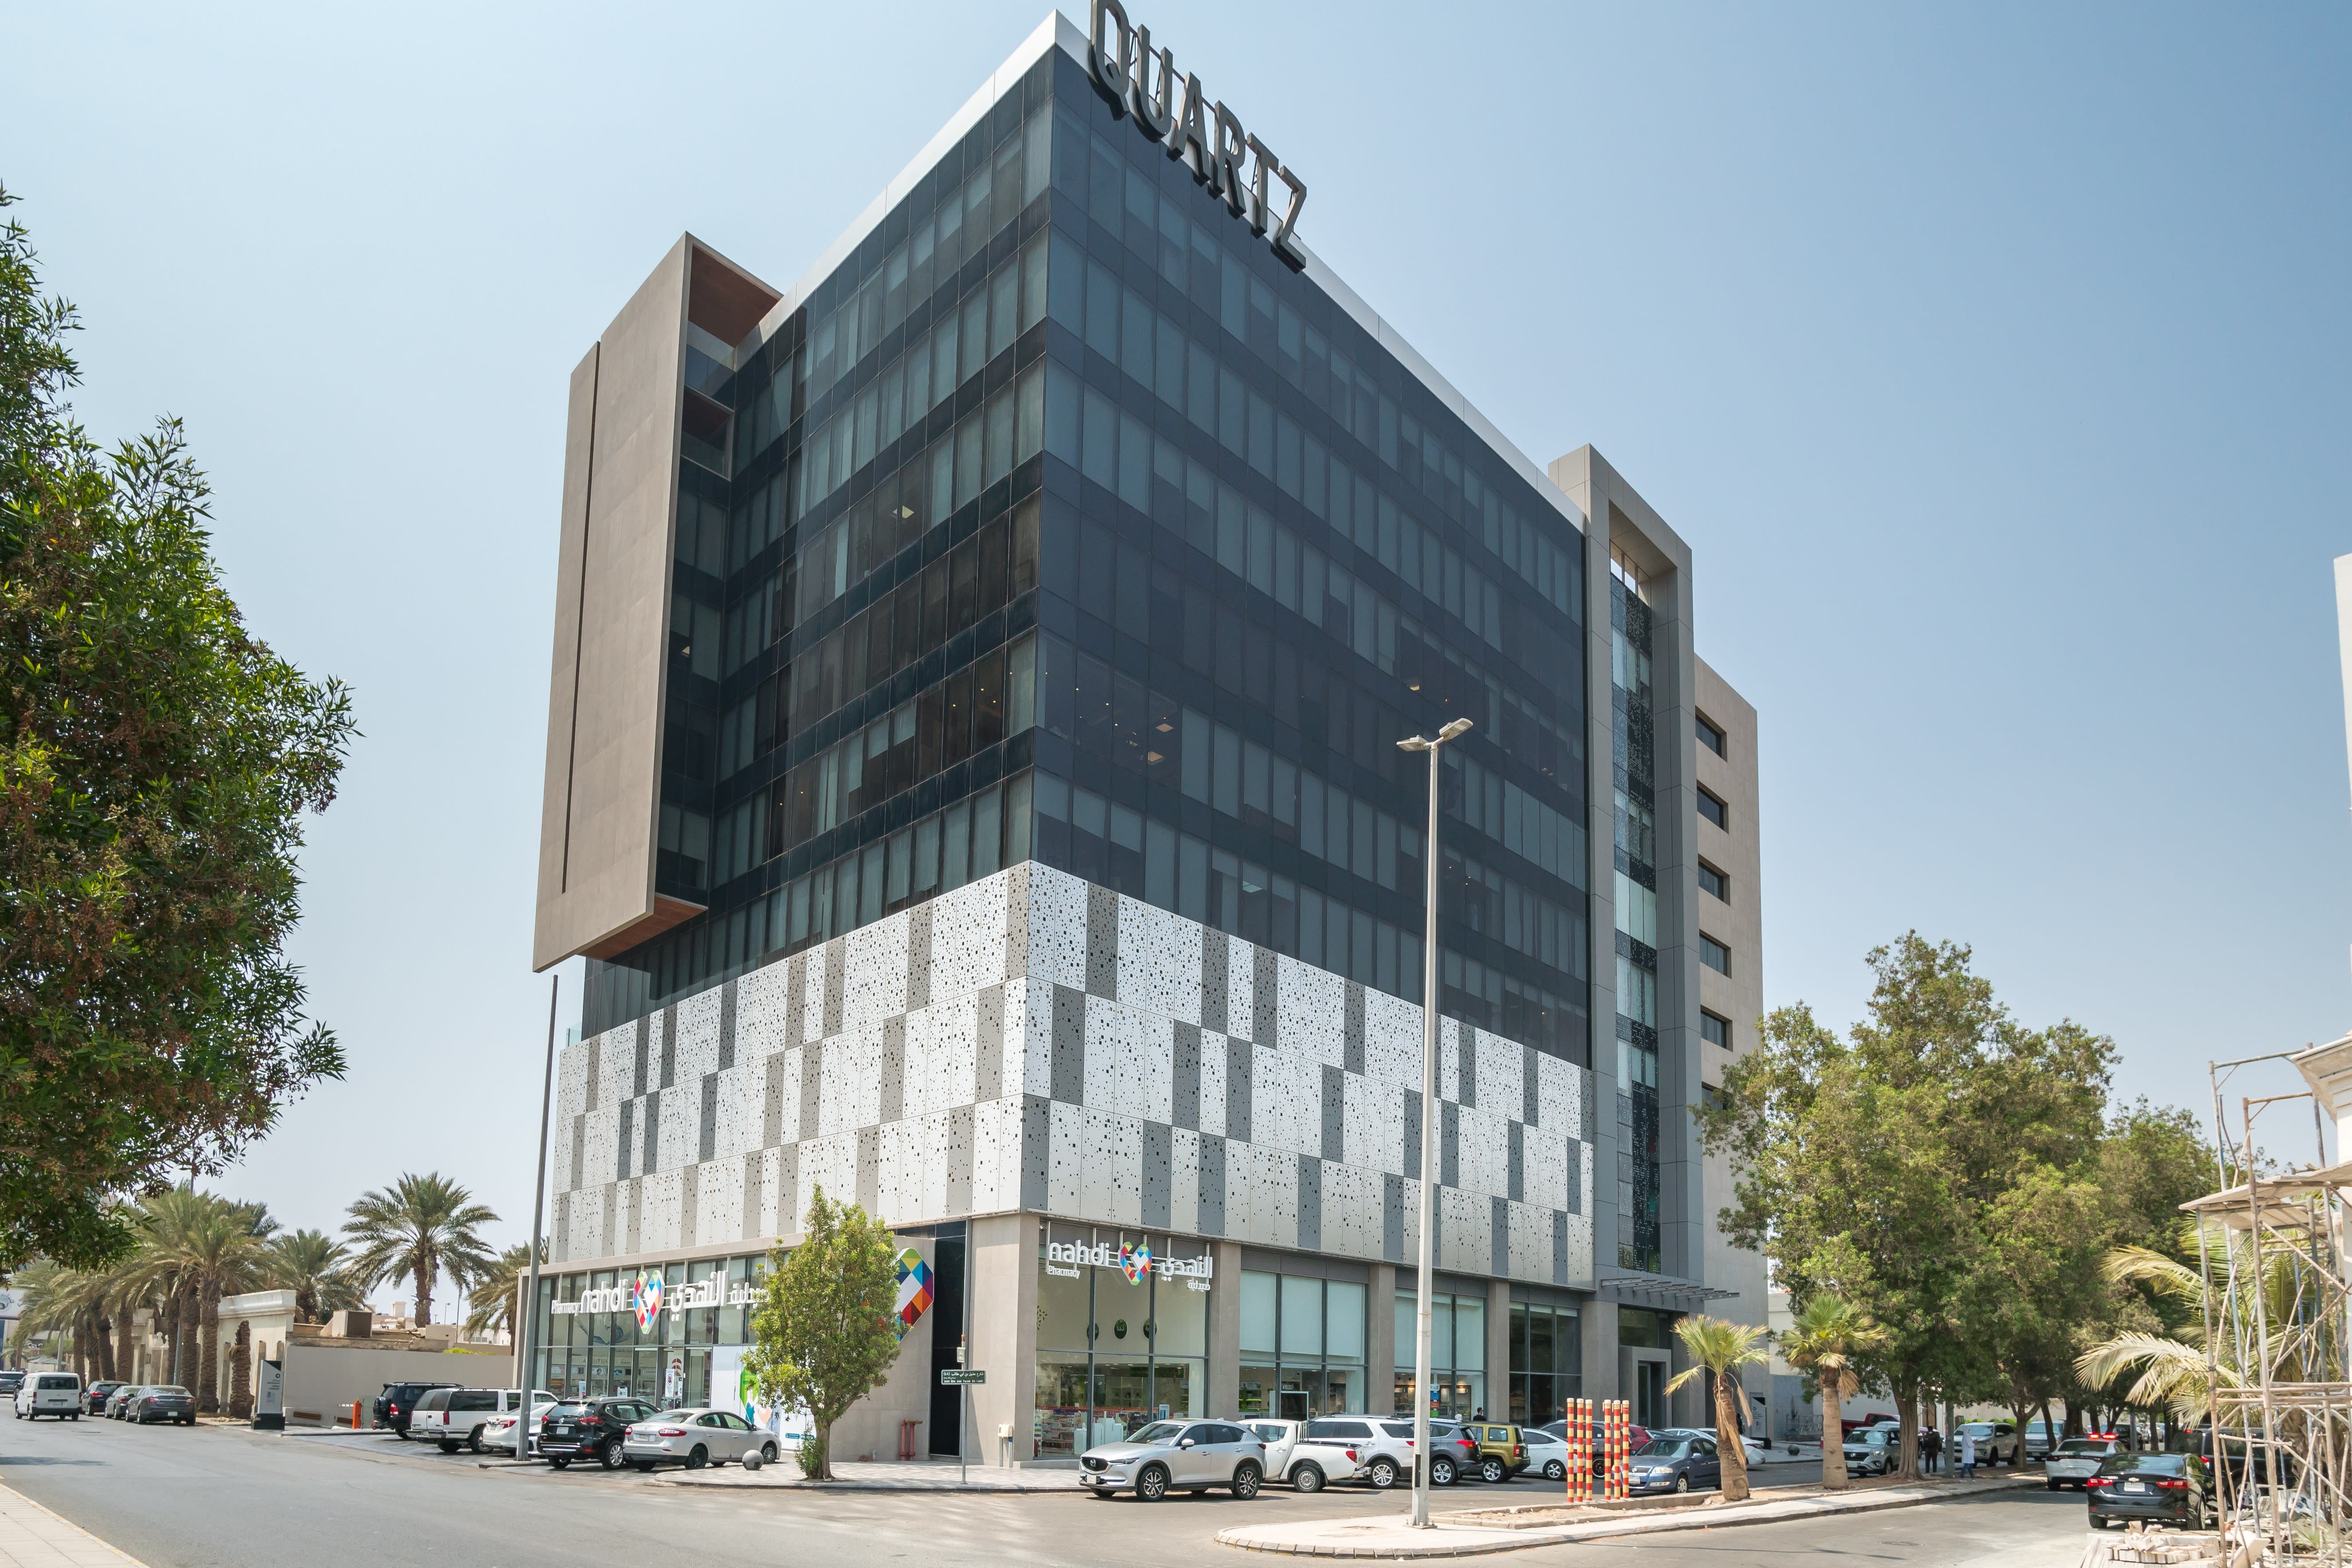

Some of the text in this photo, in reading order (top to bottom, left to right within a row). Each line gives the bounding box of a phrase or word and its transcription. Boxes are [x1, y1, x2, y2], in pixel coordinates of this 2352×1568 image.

[1089, 0, 1307, 272] QUARTZ
[1047, 1240, 1110, 1266] nahdi
[1048, 1265, 1080, 1279] Pharmacy
[1160, 1255, 1212, 1282] النهدي
[551, 1279, 628, 1317] Pharmacy nahdi
[670, 1270, 728, 1322] النهدي
[1187, 1279, 1211, 1292] صيدلية
